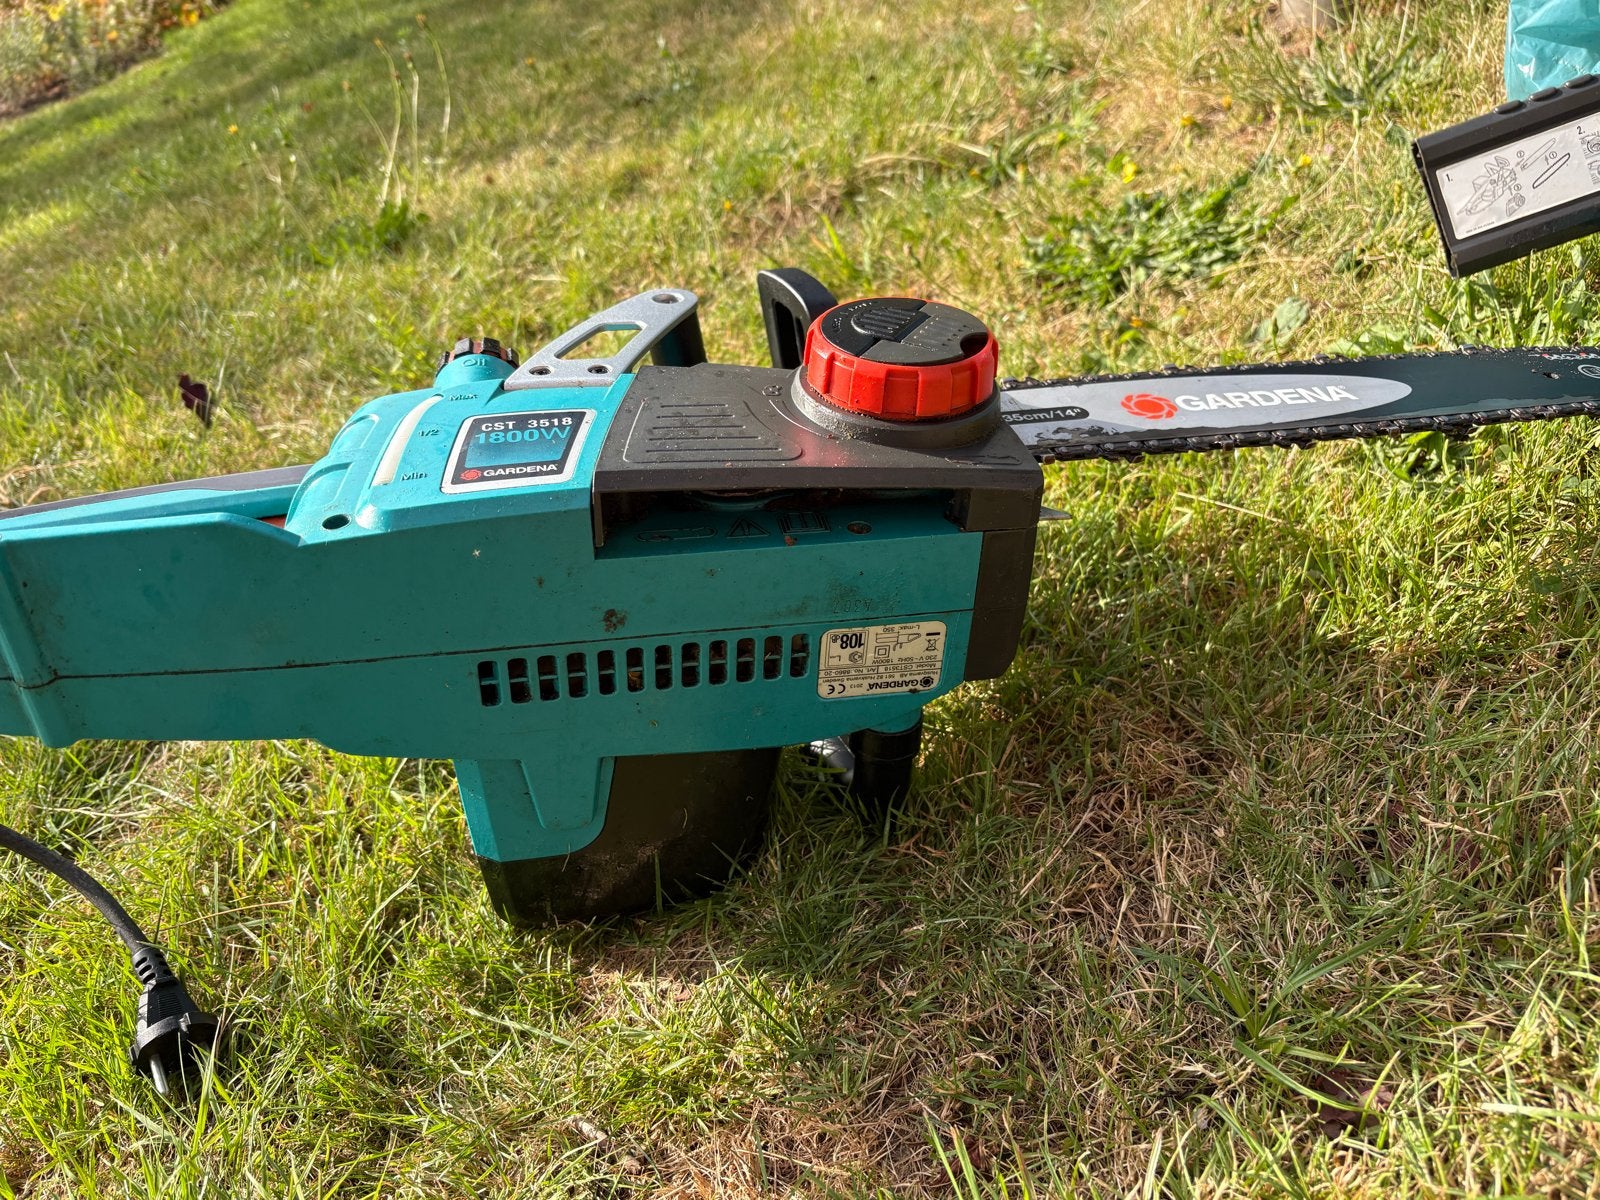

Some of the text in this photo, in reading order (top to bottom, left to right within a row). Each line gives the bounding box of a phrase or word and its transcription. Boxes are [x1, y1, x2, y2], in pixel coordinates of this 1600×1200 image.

[463, 357, 487, 367] Oil
[1175, 385, 1358, 411] GARDENA
[1001, 408, 1081, 422] 35cm/14"
[481, 417, 573, 431] CST 3518
[475, 426, 571, 444] 1800W
[484, 464, 557, 477] GARDENA
[840, 633, 865, 650] 108
[868, 679, 919, 690] GARDENA
